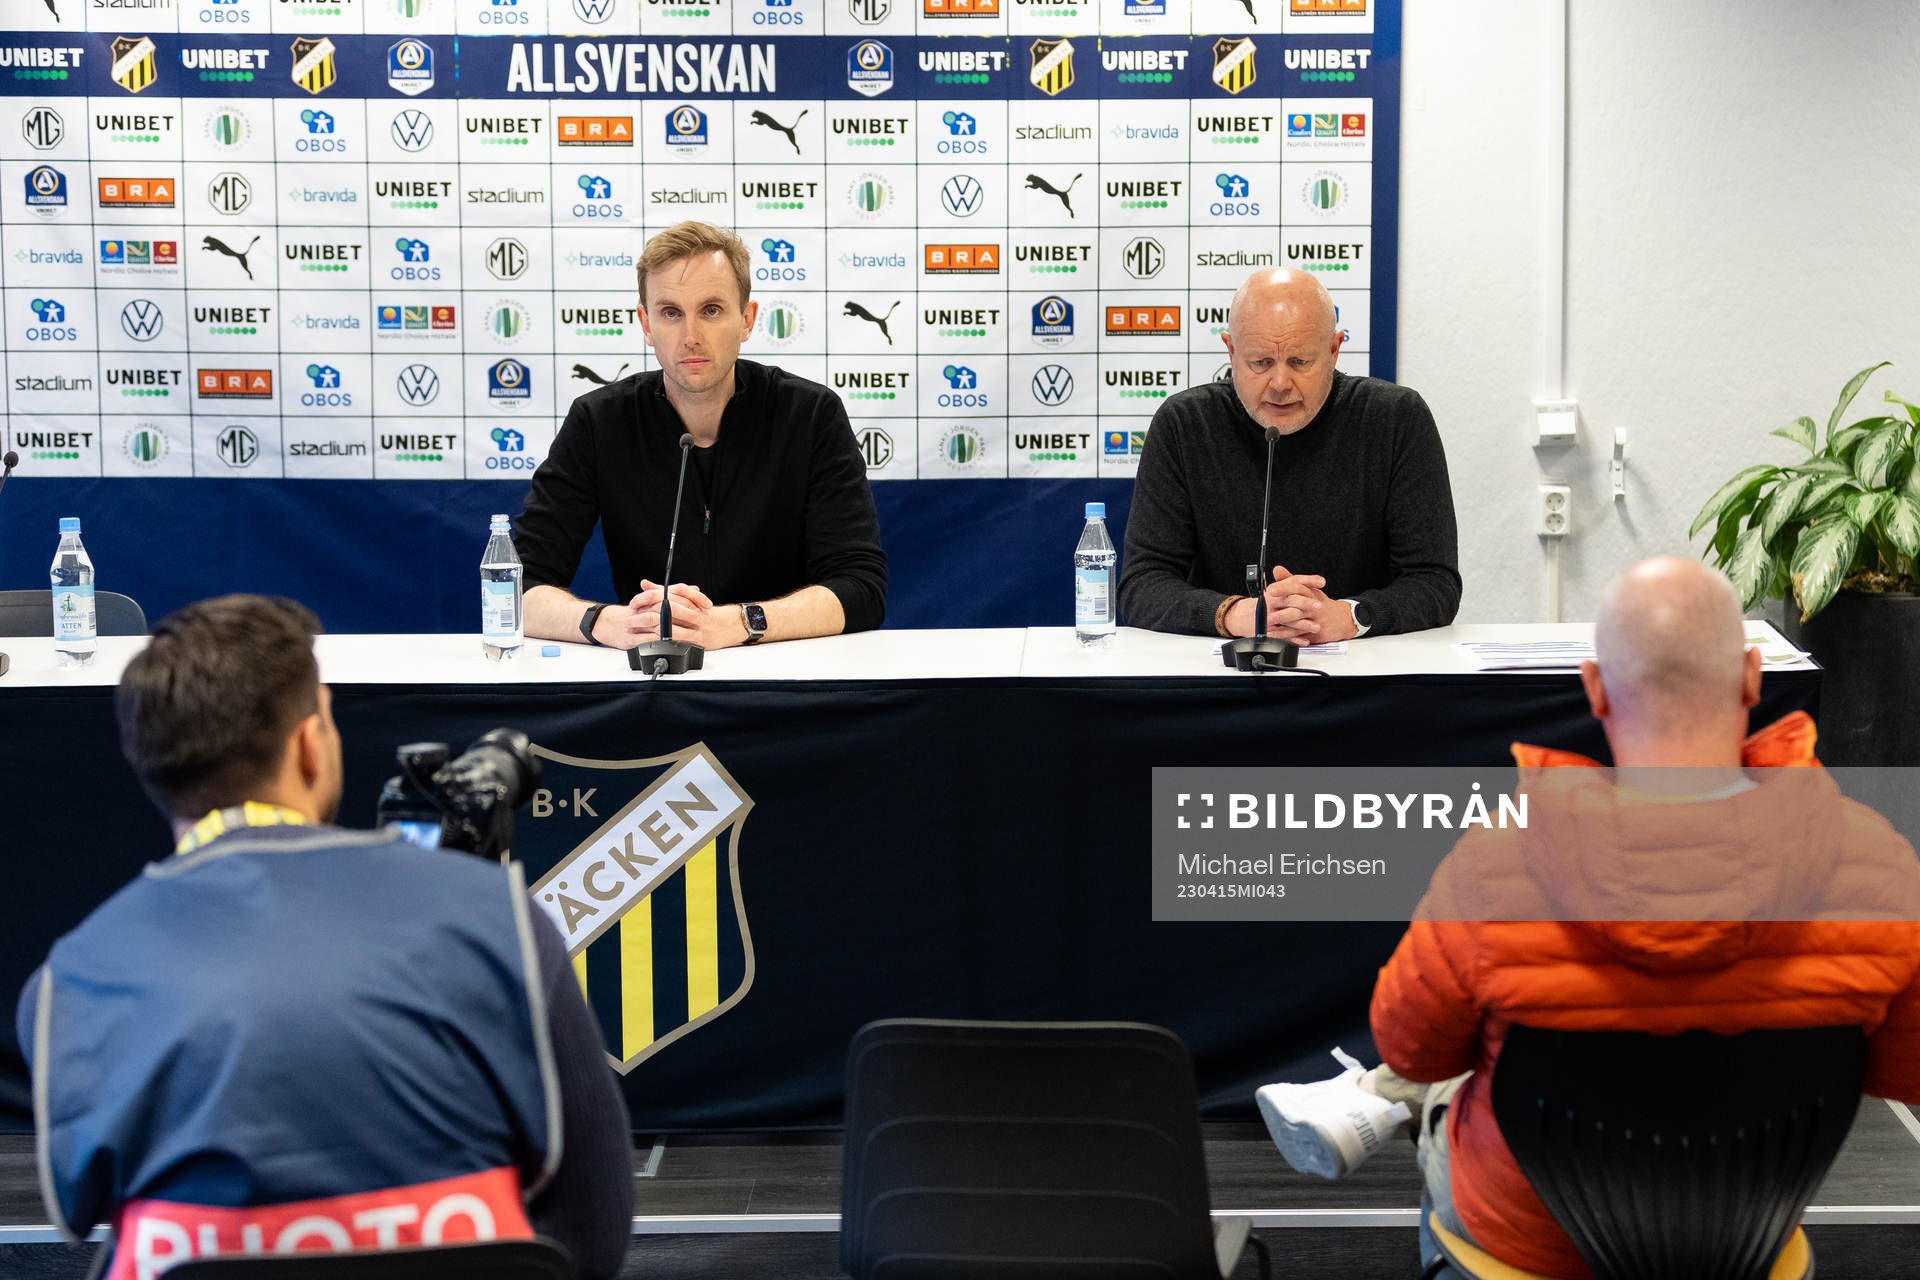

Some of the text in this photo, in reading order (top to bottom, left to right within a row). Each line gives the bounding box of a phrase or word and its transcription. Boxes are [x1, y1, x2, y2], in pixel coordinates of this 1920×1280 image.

[200, 10, 250, 23] OBOS
[479, 11, 528, 24] OBOS
[753, 12, 803, 25] OBOS
[0, 48, 83, 67] UNIBET
[182, 49, 269, 69] UNIBET
[919, 51, 1004, 71] UNIBET
[1102, 51, 1188, 71] UNIBET
[1285, 49, 1371, 69] UNIBET
[507, 43, 775, 93] ALLSVENSKAN
[26, 109, 61, 147] MG
[97, 115, 173, 130] UNIBET
[467, 118, 542, 133] UNIBET
[565, 124, 627, 136] BRA
[833, 119, 908, 134] UNIBET
[1198, 117, 1273, 132] UNIBET
[1016, 124, 1091, 139] stadium
[1126, 125, 1179, 138] bravida
[296, 139, 346, 152] OBOS
[937, 141, 987, 153] OBOS
[105, 184, 168, 198] BRA
[213, 177, 247, 211] MG
[304, 188, 356, 202] bravida
[376, 182, 451, 197] UNIBET
[468, 188, 544, 203] stadium
[651, 189, 727, 203] stadium
[743, 183, 817, 197] UNIBET
[1107, 181, 1182, 197] UNIBET
[573, 204, 622, 217] OBOS
[1210, 203, 1259, 216] OBOS
[30, 249, 83, 264] bravida
[286, 245, 361, 260] UNIBET
[490, 242, 526, 276] MG
[580, 252, 632, 266] bravida
[932, 251, 993, 264] BRA
[1016, 246, 1091, 261] UNIBET
[1126, 239, 1162, 277] MG
[1197, 251, 1272, 266] stadium
[1288, 244, 1363, 259] UNIBET
[853, 253, 905, 267] bravida
[391, 267, 440, 280] OBOS
[756, 268, 806, 280] OBOS
[195, 308, 270, 323] UNIBET
[306, 315, 360, 329] bravida
[562, 309, 635, 324] UNIBET
[925, 310, 1000, 325] UNIBET
[1113, 314, 1174, 326] BRA
[1197, 308, 1231, 323] UNI
[26, 328, 76, 341] OBOS
[16, 376, 92, 390] stadium
[107, 370, 181, 385] UNIBET
[204, 375, 266, 388] BRA
[835, 373, 909, 388] UNIBET
[1106, 371, 1181, 386] UNIBET
[301, 393, 352, 406] OBOS
[938, 394, 987, 407] OBOS
[17, 433, 93, 447] UNIBET
[221, 428, 256, 463] MG
[381, 435, 456, 450] UNIBET
[1015, 434, 1090, 449] UNIBET
[289, 441, 366, 456] stadium
[485, 457, 537, 472] OBOS
[544, 781, 719, 934] ÄCKEN
